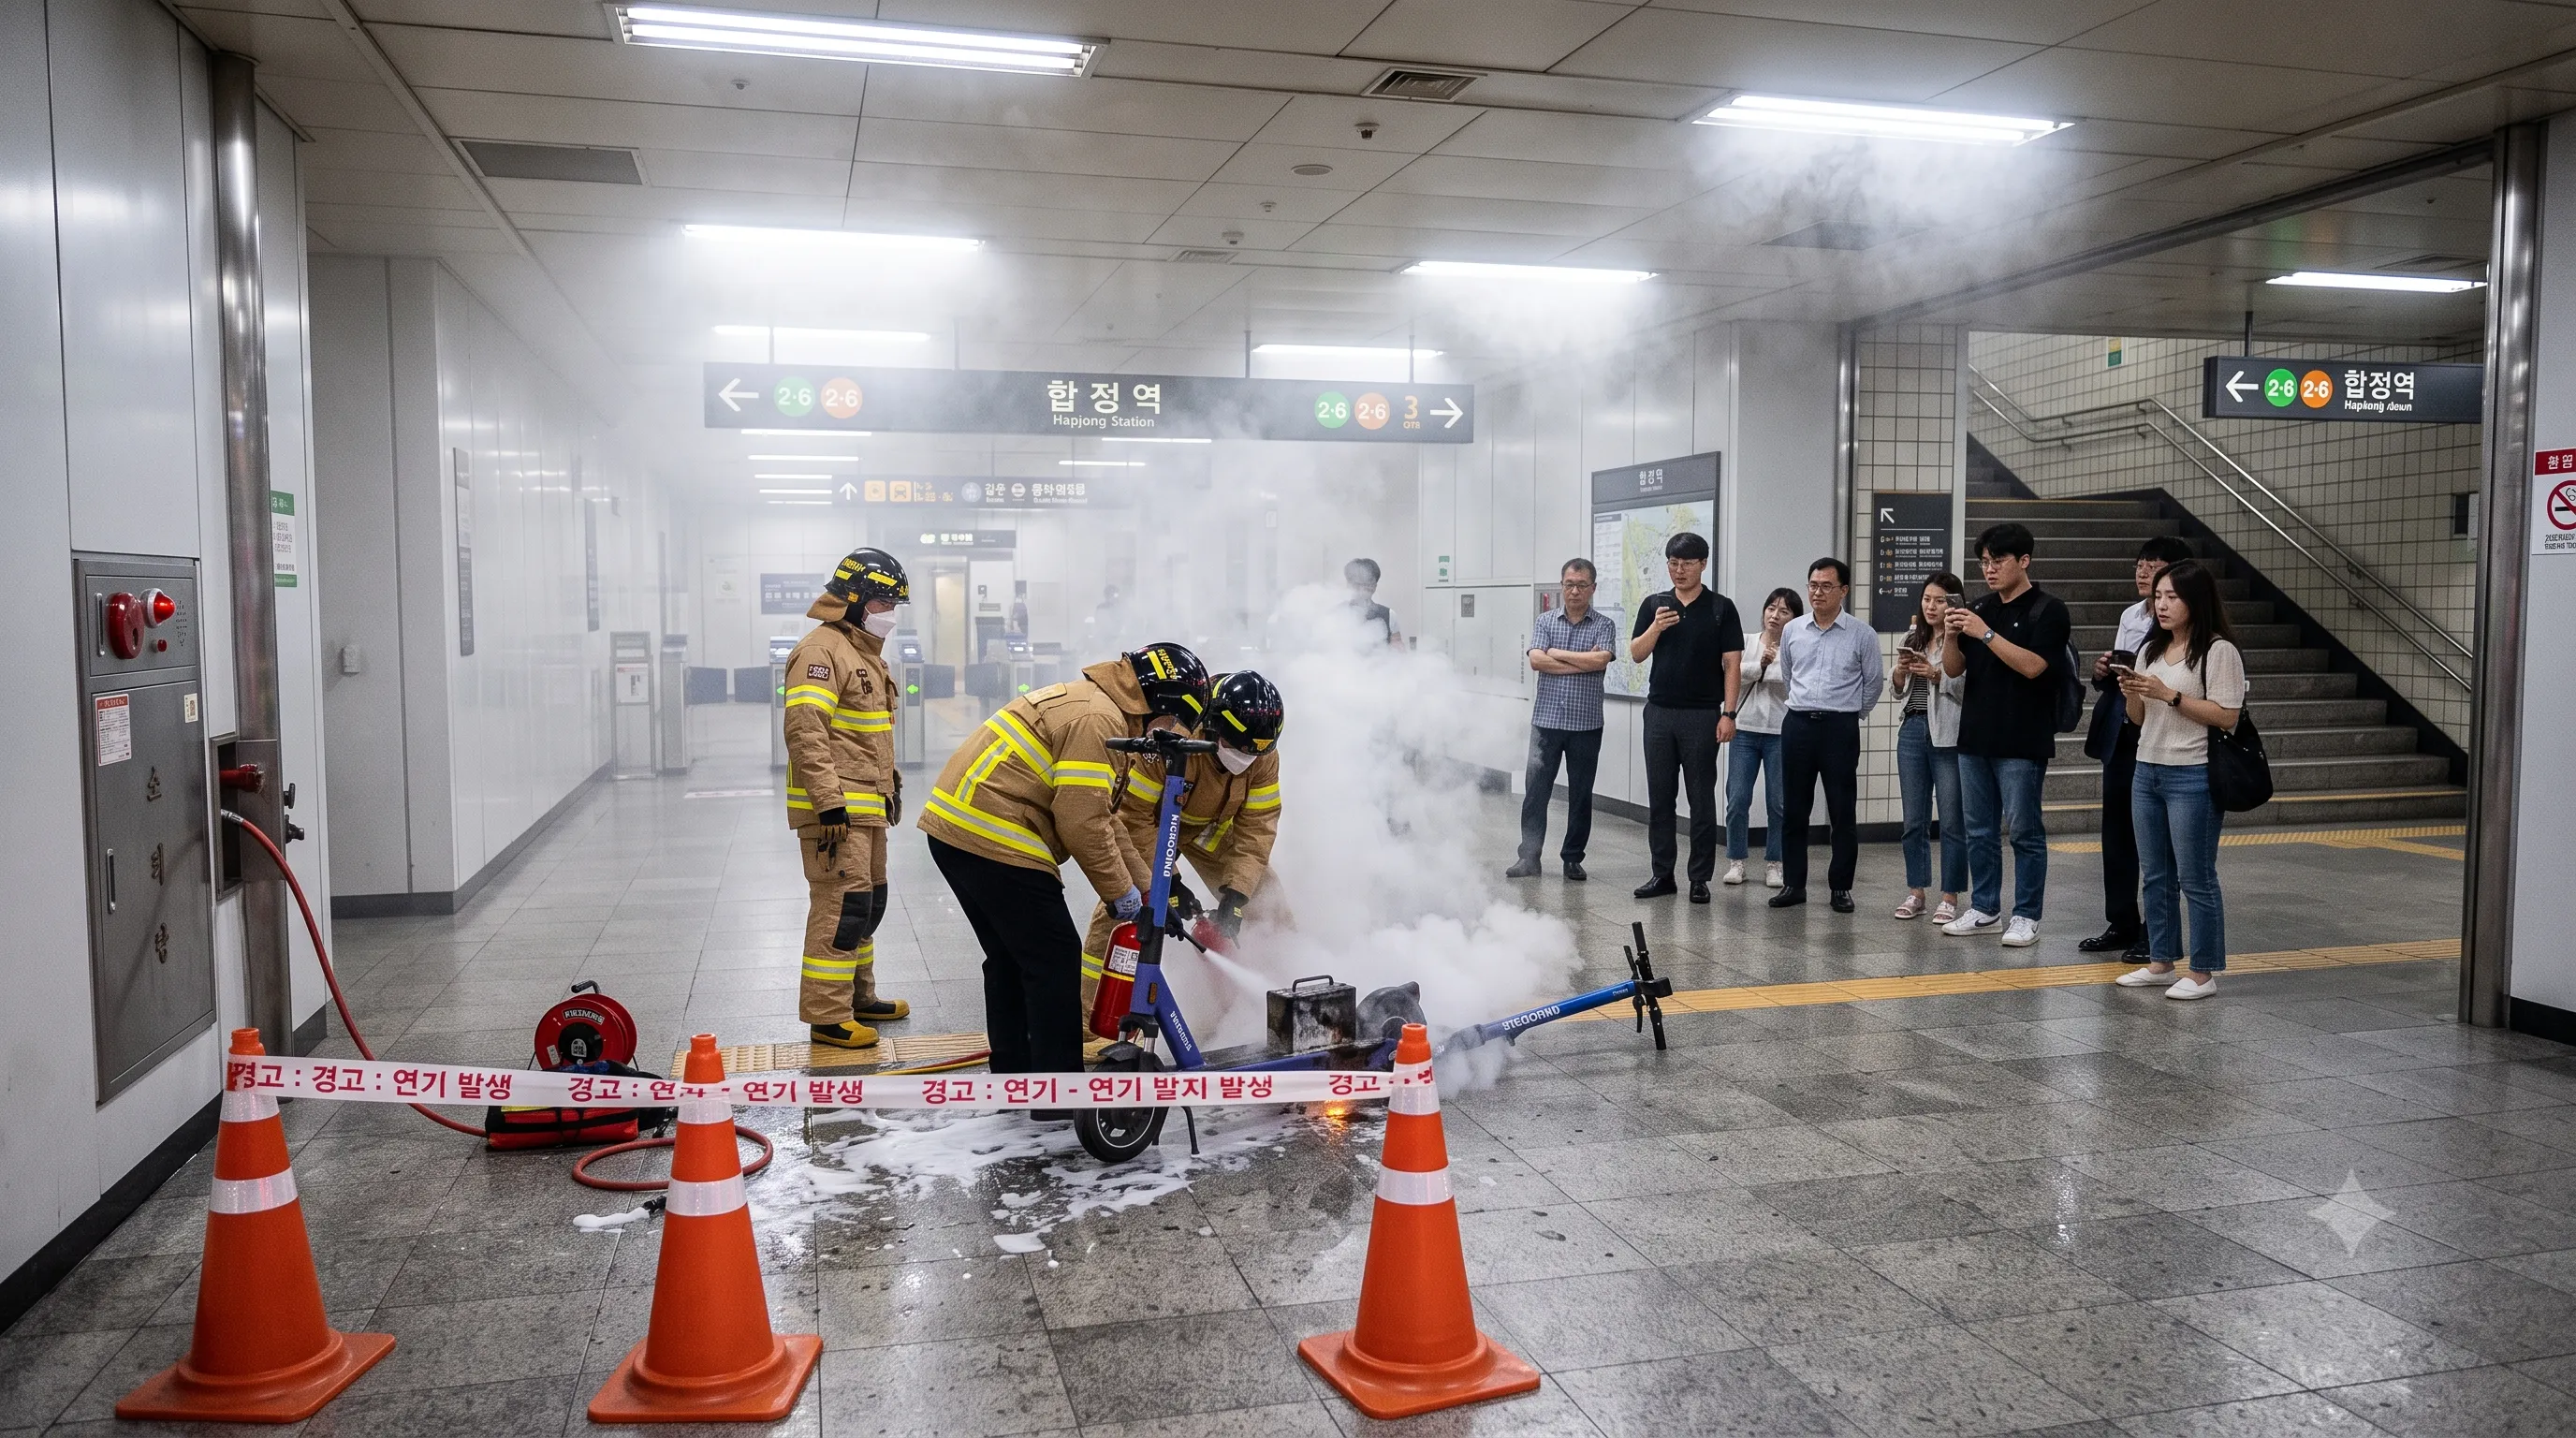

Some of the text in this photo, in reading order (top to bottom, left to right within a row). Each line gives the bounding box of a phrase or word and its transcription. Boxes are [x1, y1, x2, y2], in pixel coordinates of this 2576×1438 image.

[2344, 369, 2415, 401] 합정역
[1404, 395, 1418, 419] 3
[1053, 414, 1155, 429] Hapjong Station
[312, 1065, 366, 1093] 경고
[393, 1068, 446, 1098] 연기
[458, 1072, 512, 1100] 발생
[568, 1077, 622, 1103] 경고
[743, 1080, 797, 1103] 연기
[808, 1079, 864, 1105] 발생
[922, 1079, 975, 1105] 경고
[1003, 1078, 1057, 1104] 연기
[1089, 1077, 1141, 1103] 연기
[1153, 1076, 1208, 1101] 발지
[1220, 1074, 1273, 1100] 발생
[1328, 1074, 1381, 1095] 경고
